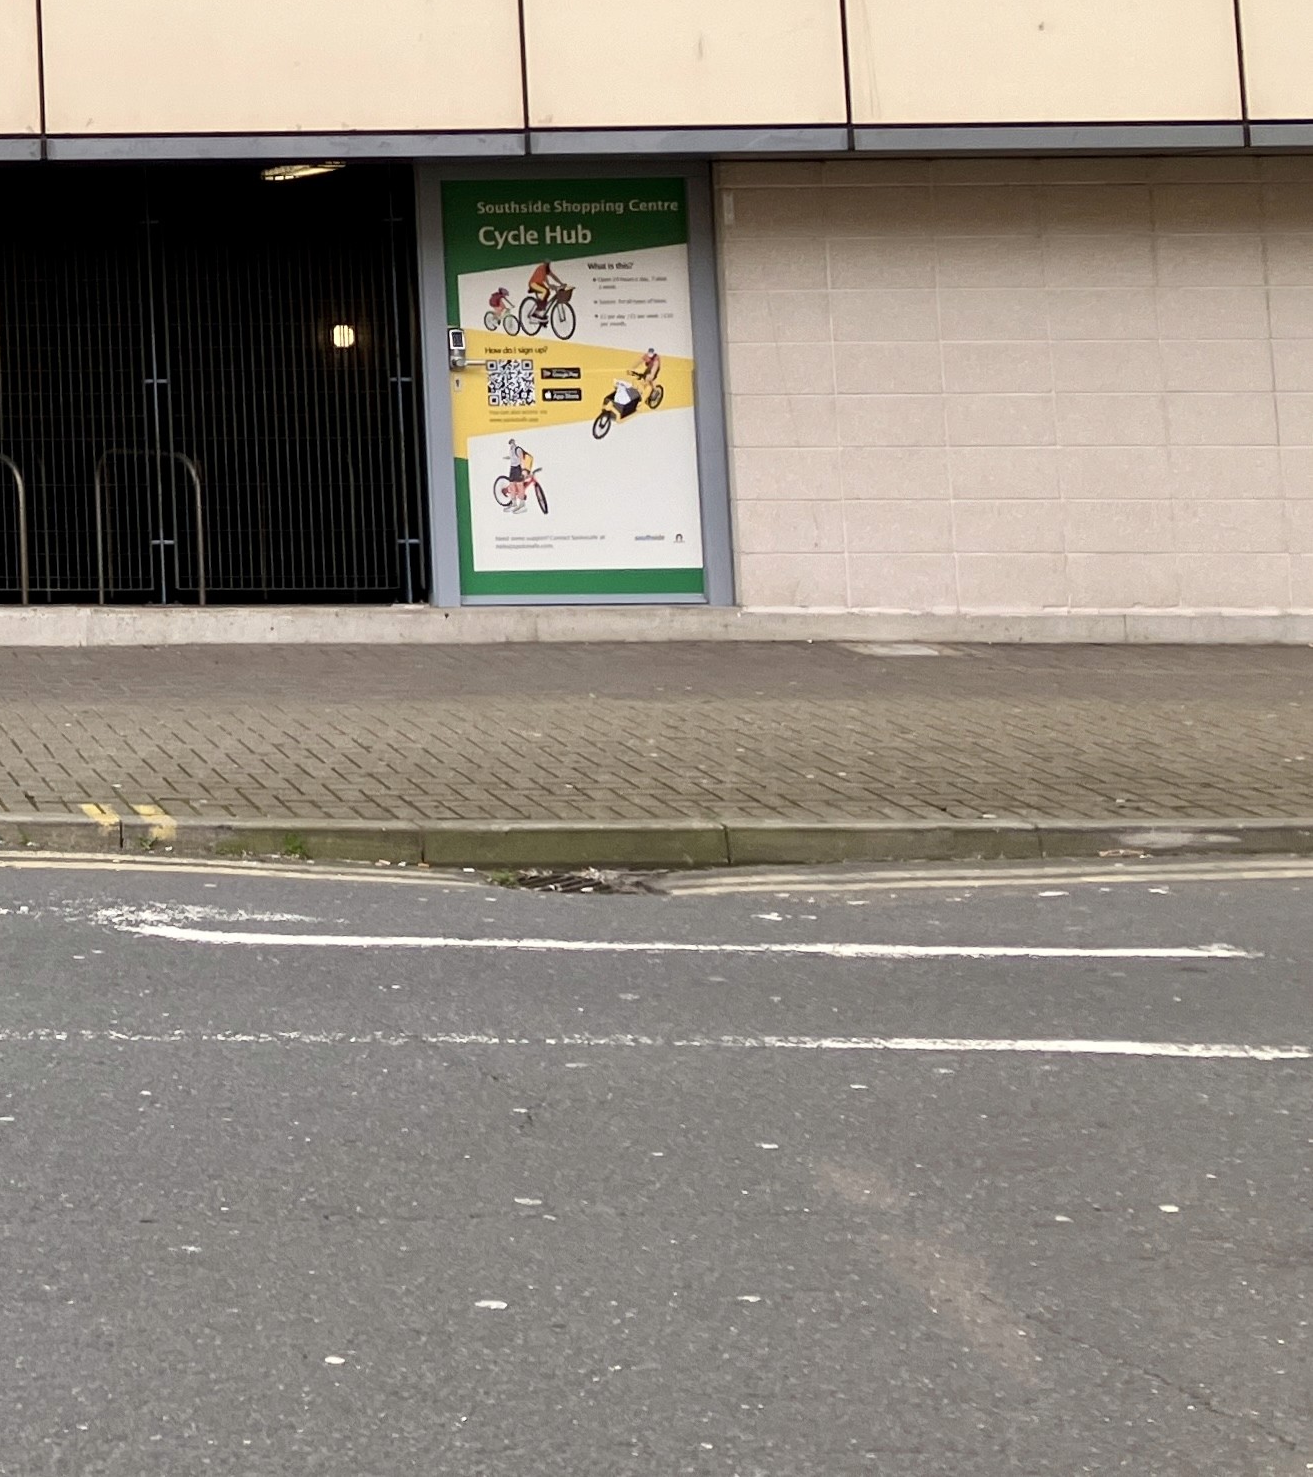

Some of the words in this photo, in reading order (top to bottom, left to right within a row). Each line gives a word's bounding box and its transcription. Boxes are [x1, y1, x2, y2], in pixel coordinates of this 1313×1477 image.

[477, 200, 551, 215] Southside
[553, 199, 624, 215] Shopping
[628, 198, 679, 212] Centre
[478, 225, 539, 250] Cycle
[545, 224, 592, 245] Hub
[587, 262, 607, 270] What
[518, 347, 533, 356] sign
[534, 346, 548, 355] up?
